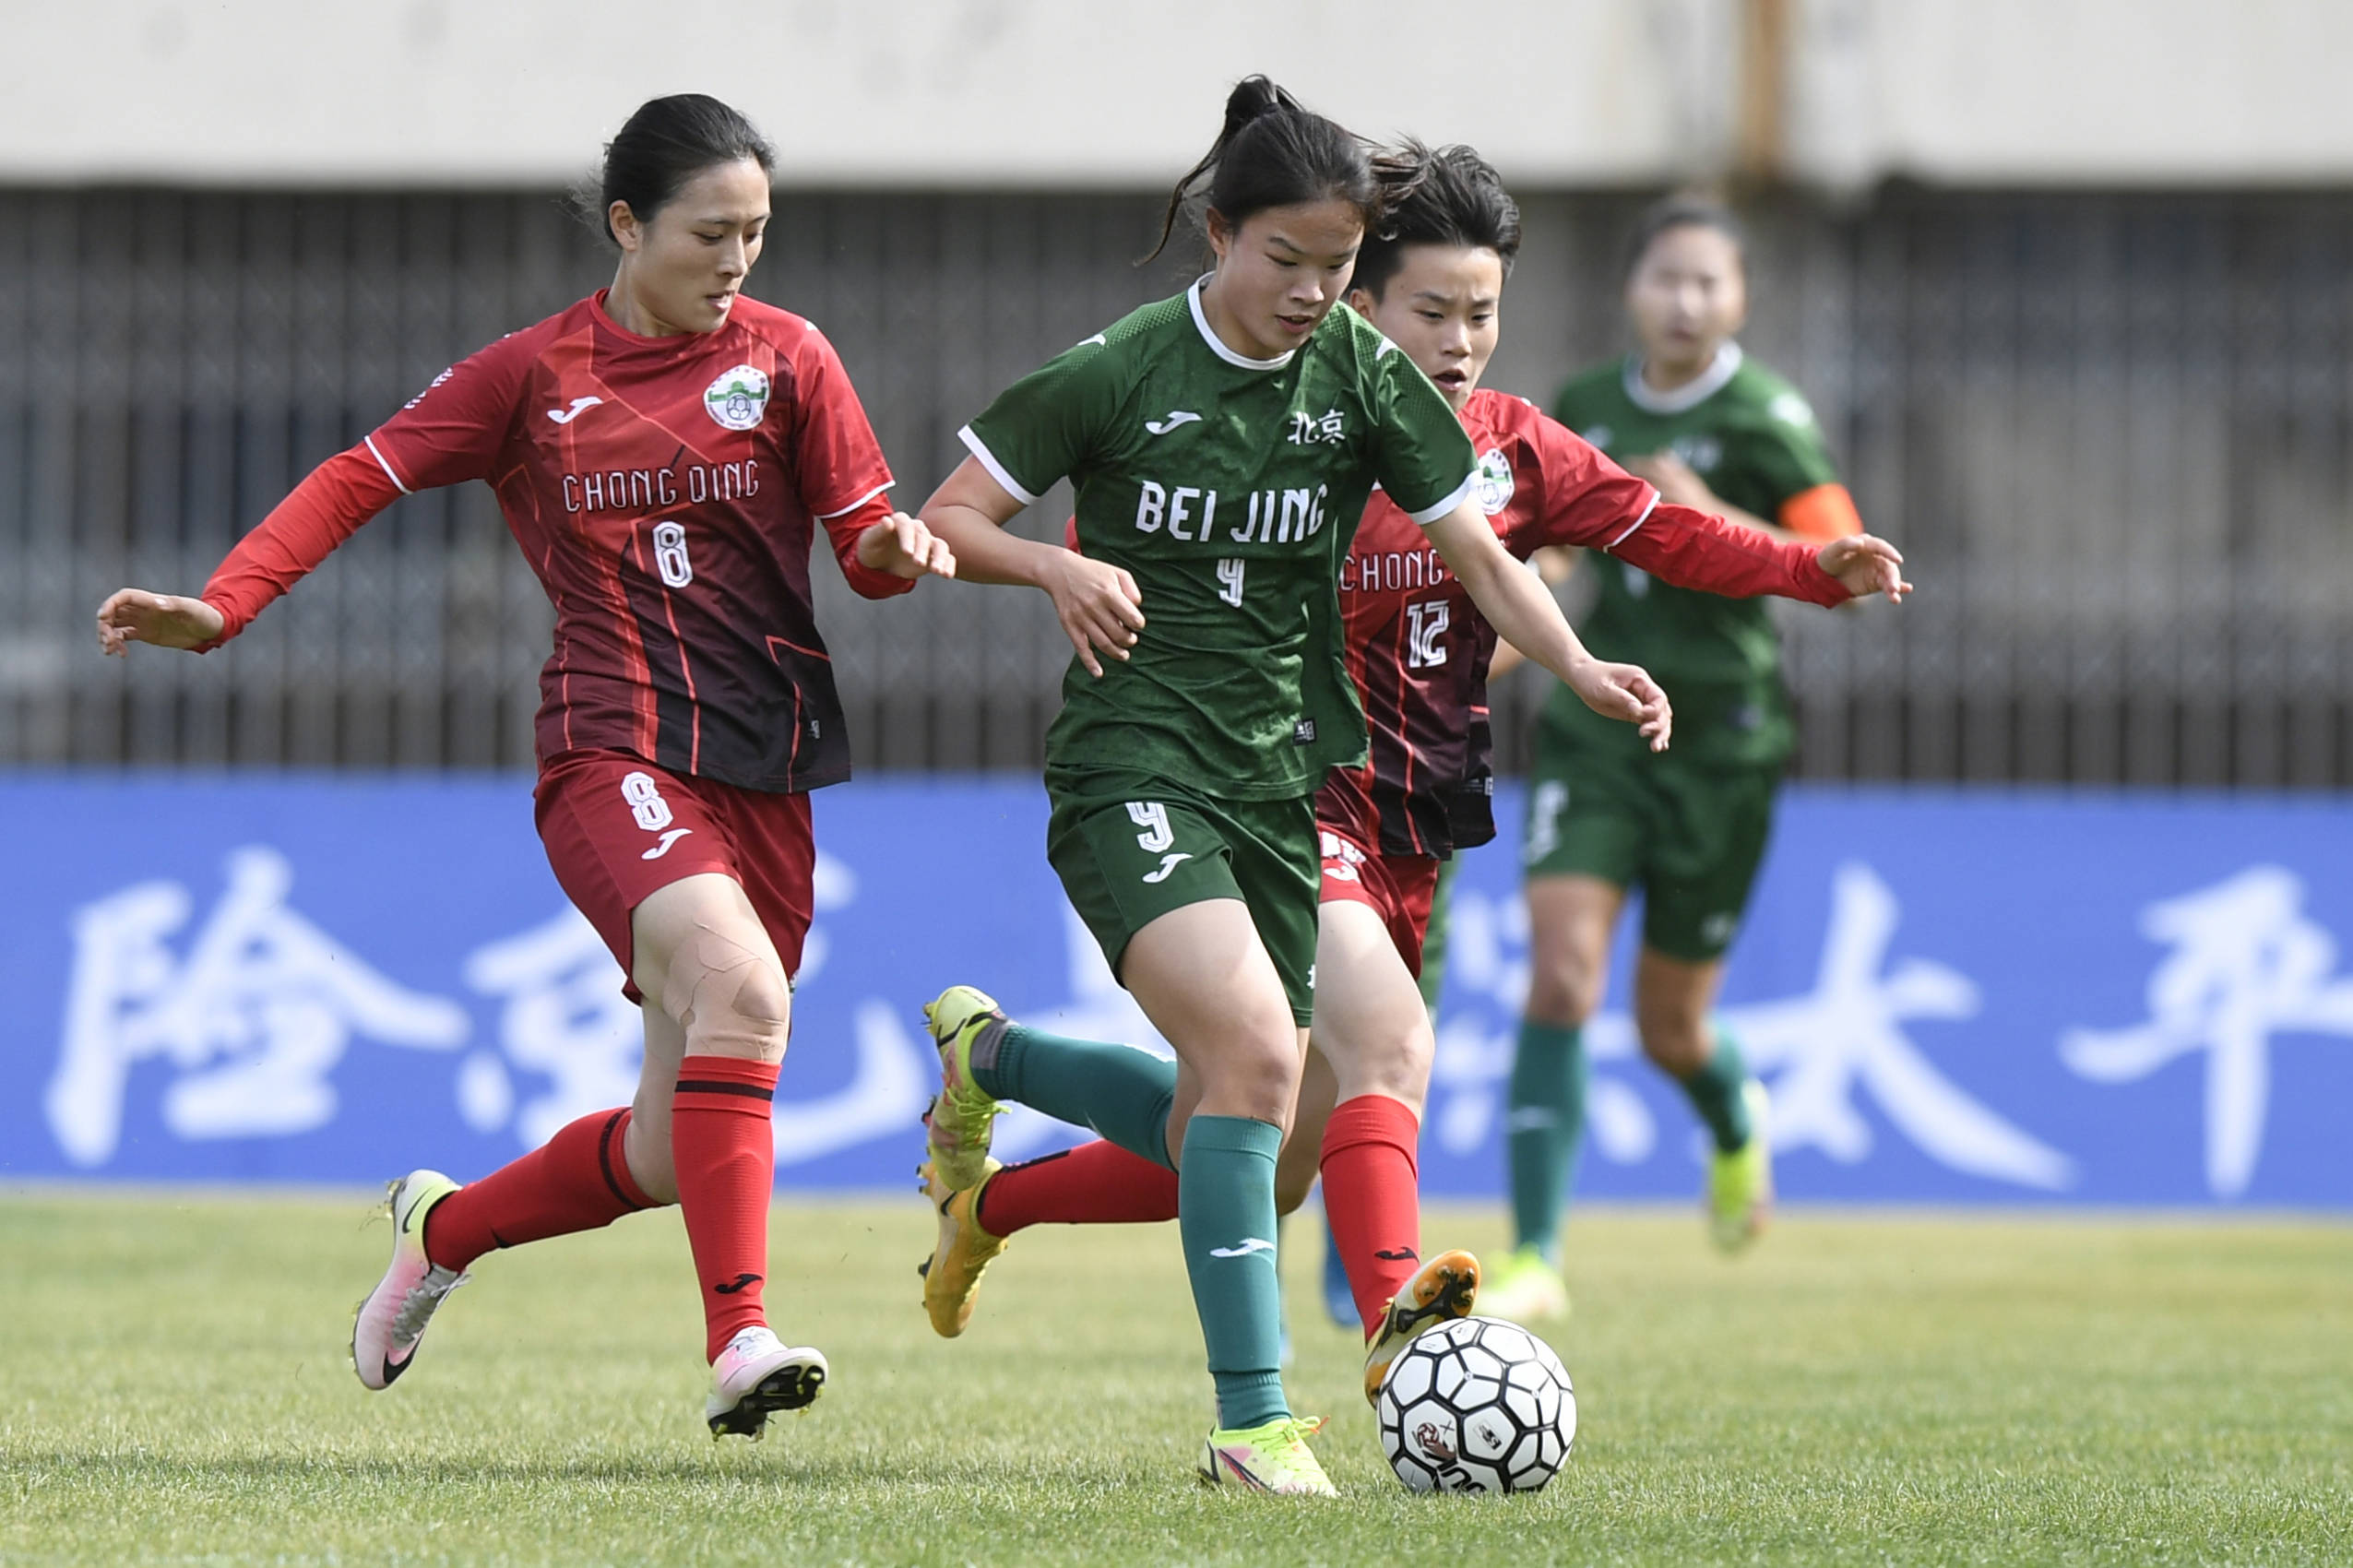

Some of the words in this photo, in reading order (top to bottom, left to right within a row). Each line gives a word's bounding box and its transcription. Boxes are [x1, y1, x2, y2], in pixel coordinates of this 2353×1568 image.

[1287, 409, 1346, 445] 北京
[562, 467, 678, 513] CHONG
[688, 458, 760, 504] QING
[1135, 480, 1217, 541] BEI
[1230, 482, 1328, 543] JING
[652, 520, 694, 589] 8
[1216, 558, 1245, 609] 9
[1406, 600, 1450, 670] 12
[620, 771, 673, 831] 8
[1124, 802, 1175, 852] 9
